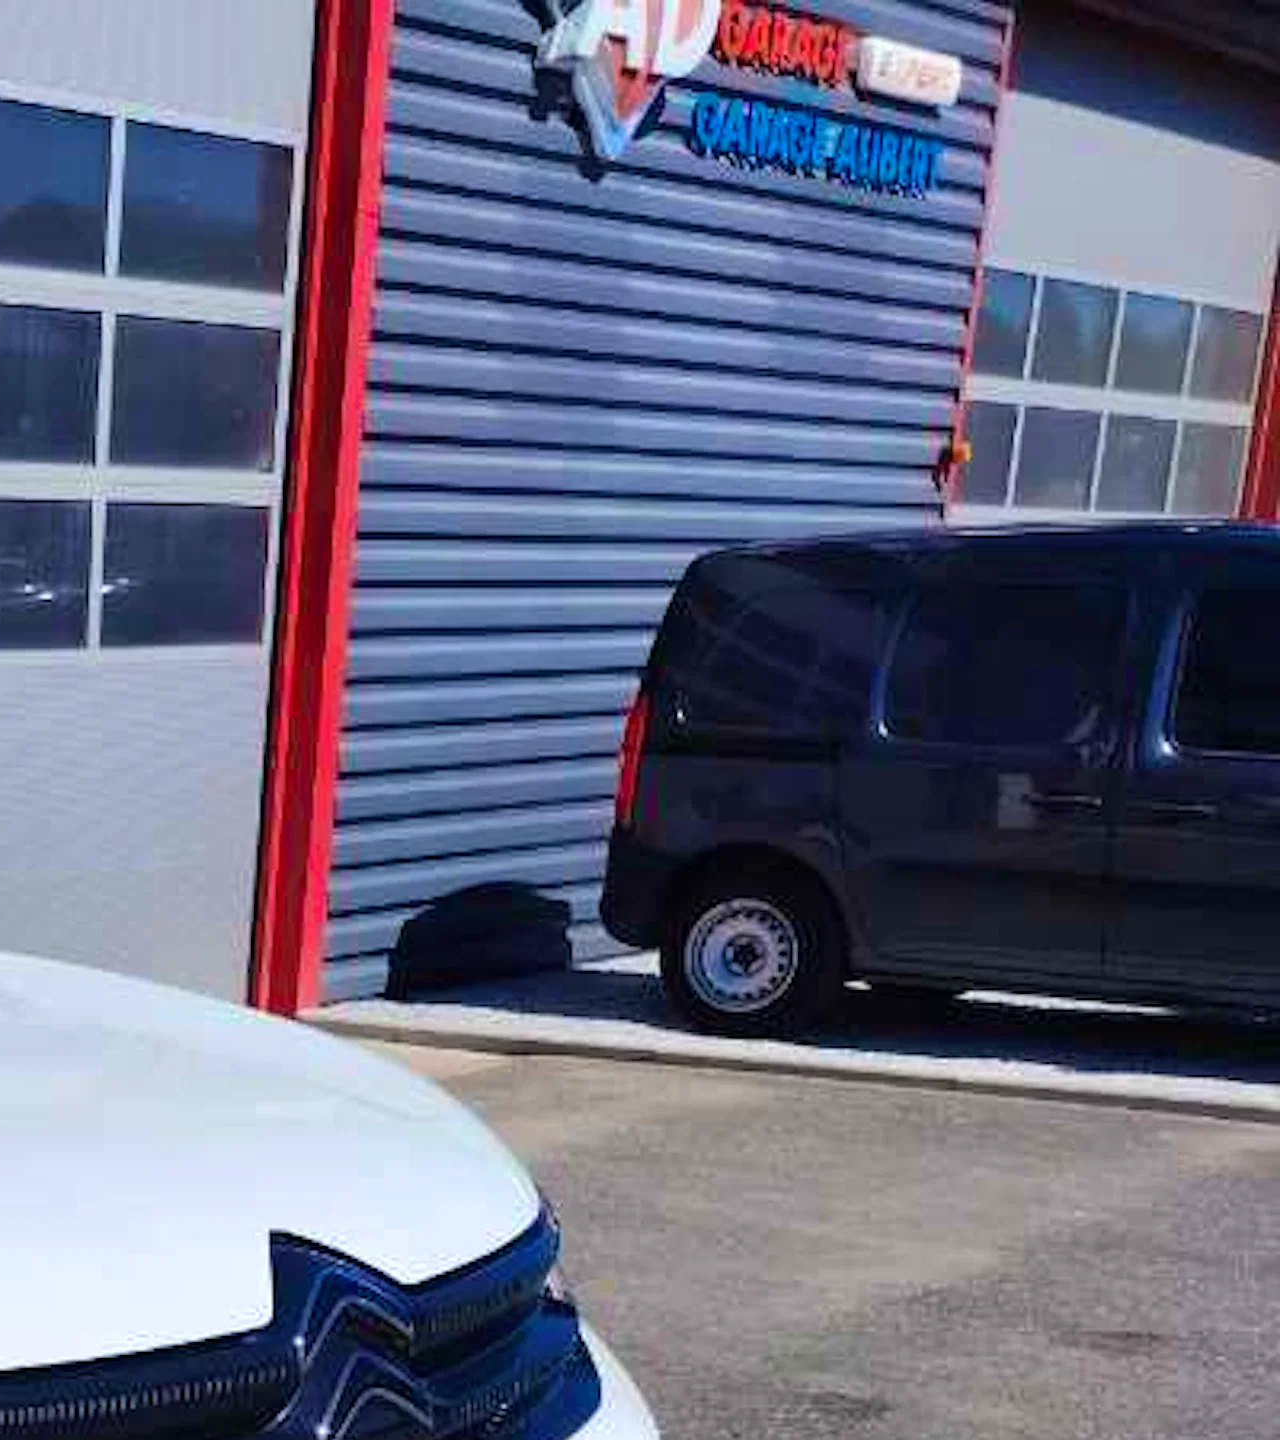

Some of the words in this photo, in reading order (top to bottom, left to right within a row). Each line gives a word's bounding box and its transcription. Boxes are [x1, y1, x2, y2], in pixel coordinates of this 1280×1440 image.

[717, 0, 854, 84] GARAGE
[693, 92, 834, 175] GARAGE
[838, 124, 943, 190] ALIBERT
